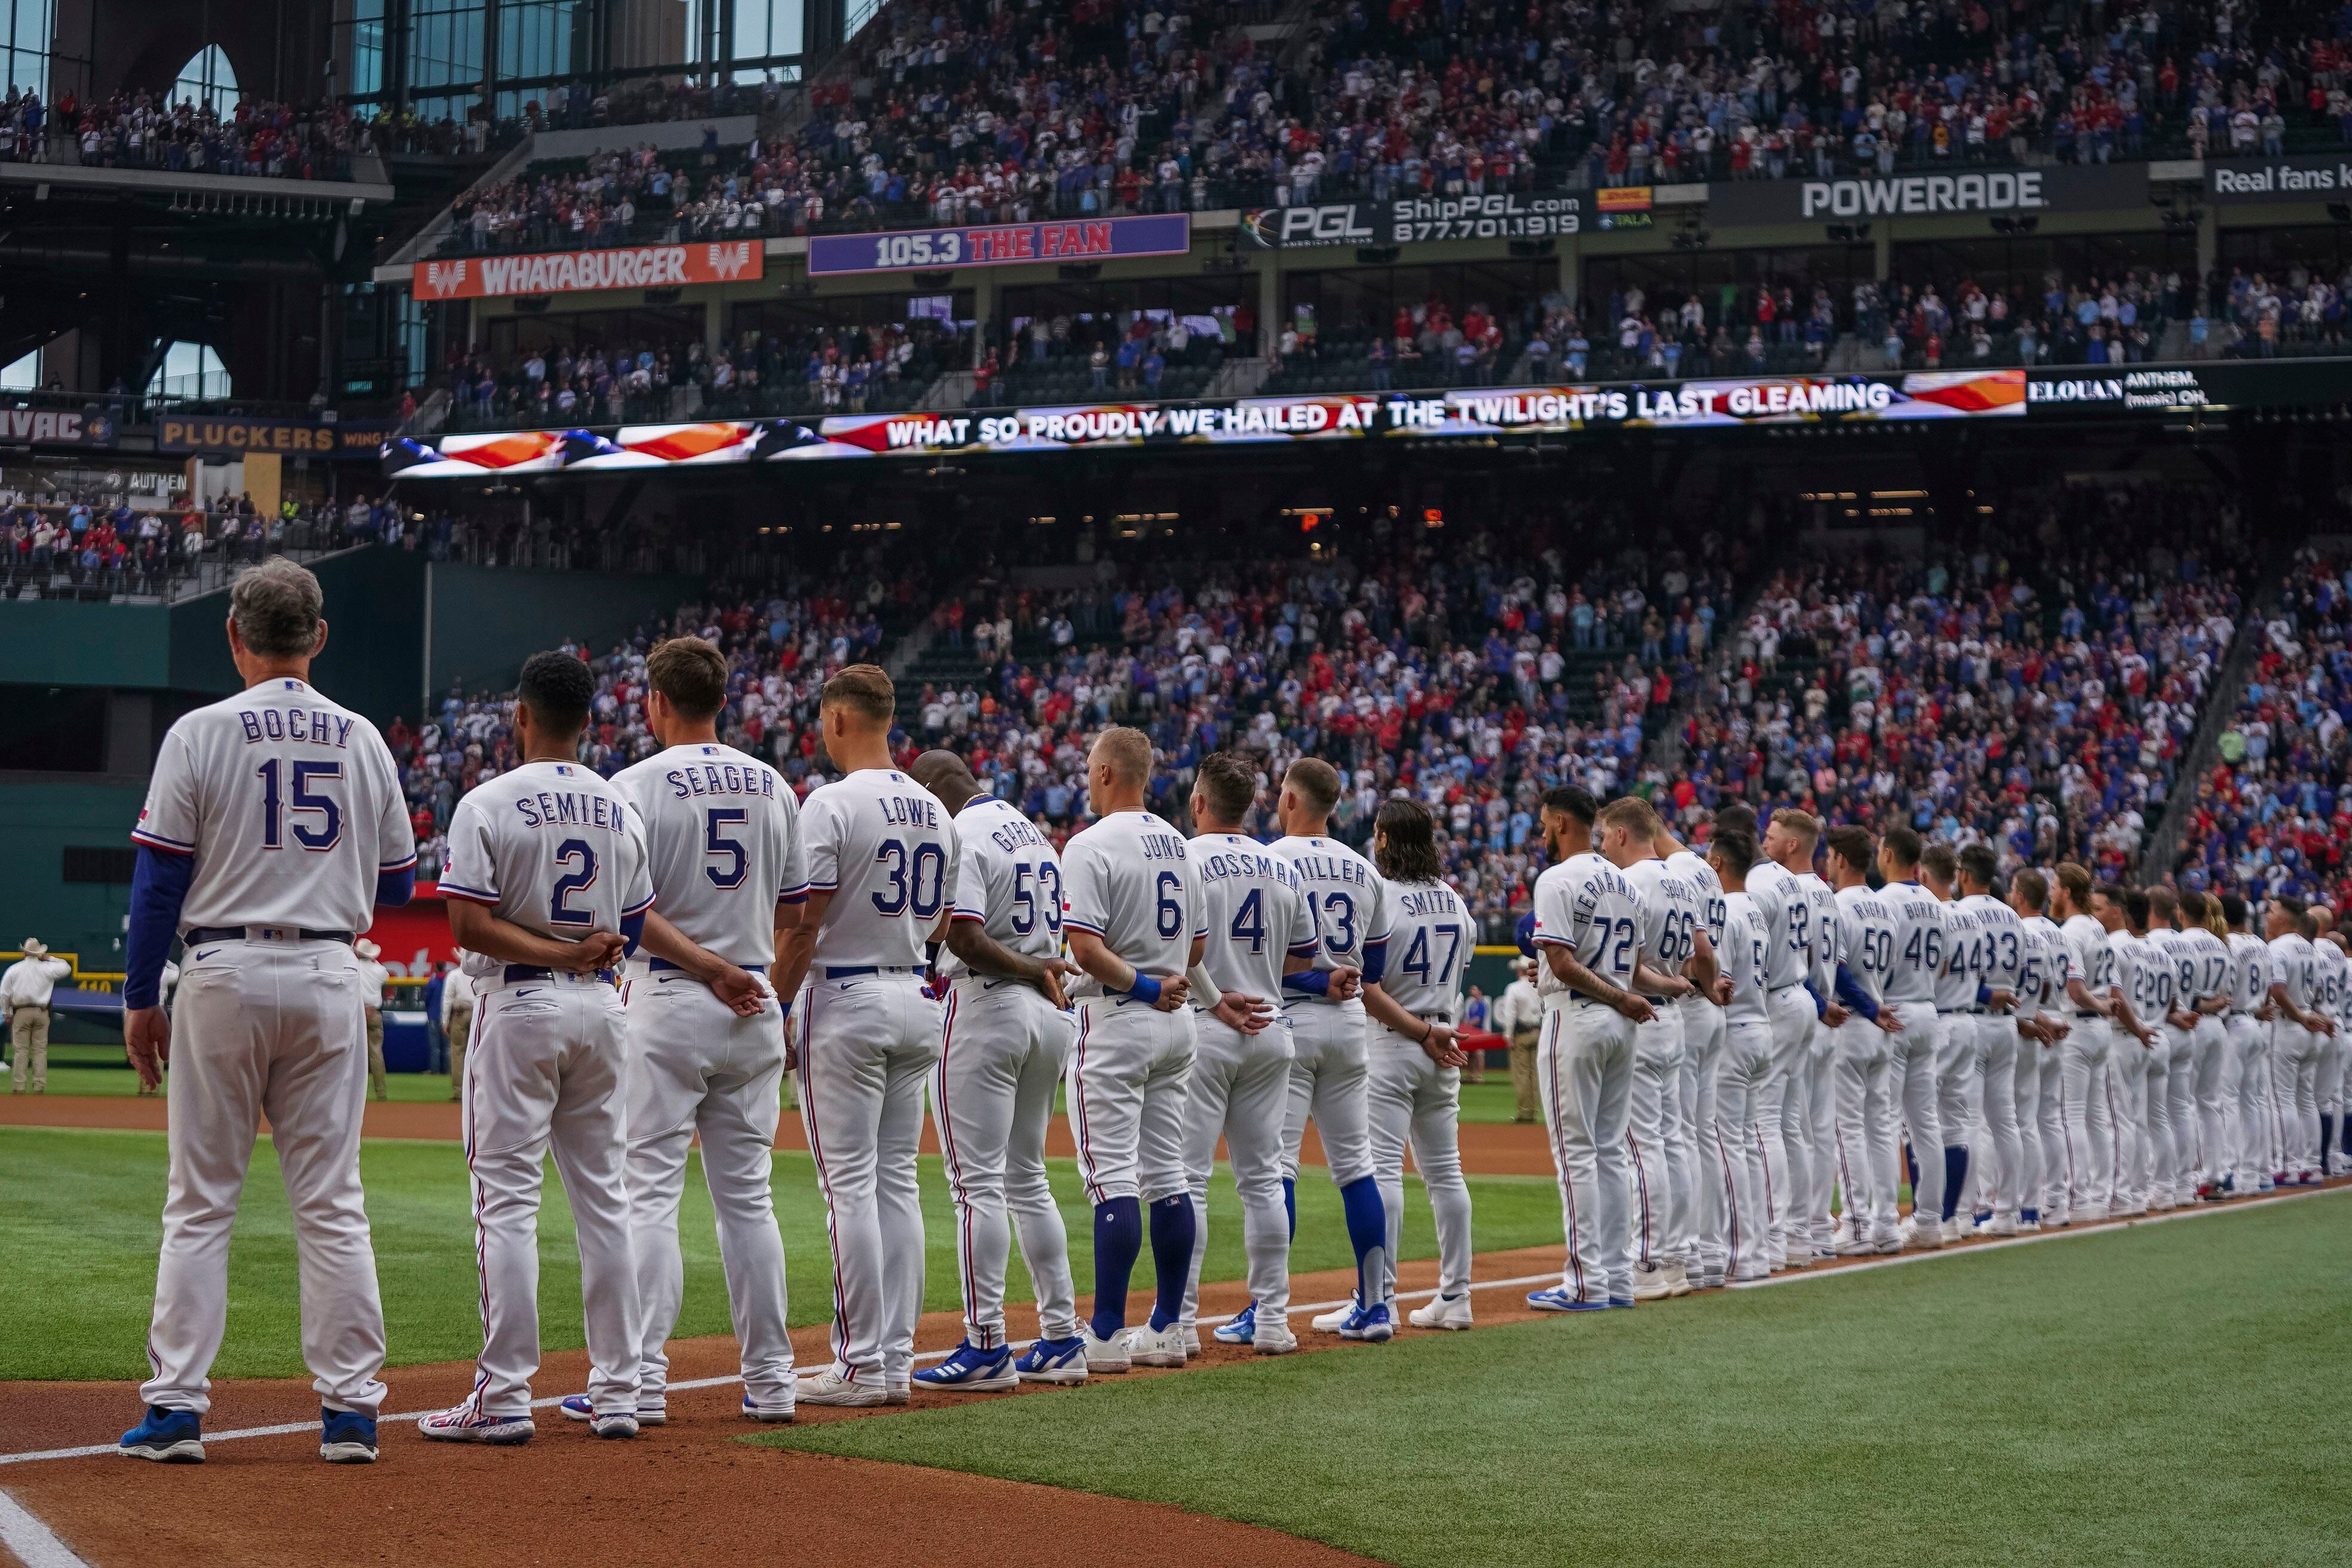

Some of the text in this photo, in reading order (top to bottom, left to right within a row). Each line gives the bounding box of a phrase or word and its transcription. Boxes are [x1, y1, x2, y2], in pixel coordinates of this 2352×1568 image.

[1802, 172, 2043, 218] POWERADE
[2215, 166, 2273, 192] Real
[2278, 165, 2335, 190] fans
[1281, 204, 1374, 239] PGL
[1392, 194, 1579, 220] ShipPGL.com
[1392, 214, 1579, 242] 877.701.1919
[875, 222, 1113, 267] 105.3 THE FAN
[481, 247, 688, 295] WHATABURGER
[164, 422, 334, 451] PLUCKERS
[887, 382, 1891, 446] WHAT SO PROUDLY WE HAILED AT THE TWILIGHT'S LAST GLEAMING
[239, 708, 356, 749] BOCHY
[256, 755, 345, 852] 15
[666, 765, 775, 801] SEAGER
[516, 792, 625, 836] SEMIEN
[878, 796, 939, 830] LOWE
[705, 806, 751, 890] 5
[1141, 834, 1187, 860] JUNG
[549, 837, 600, 928] 2
[871, 838, 950, 920] 30
[1010, 861, 1063, 937] 53
[1155, 871, 1185, 941] 6
[1230, 887, 1268, 956] 4
[1307, 891, 1358, 956] 13
[1401, 890, 1458, 917] SMITH
[1788, 901, 1813, 951] 52
[1852, 901, 1893, 923] RAGAN
[1402, 924, 1462, 987] 47
[1586, 916, 1637, 975] 72
[1658, 908, 1696, 964] 66
[1863, 926, 1894, 973] 50
[1904, 926, 1942, 971] 46
[1949, 938, 1982, 982] 44
[2202, 957, 2226, 991] 17
